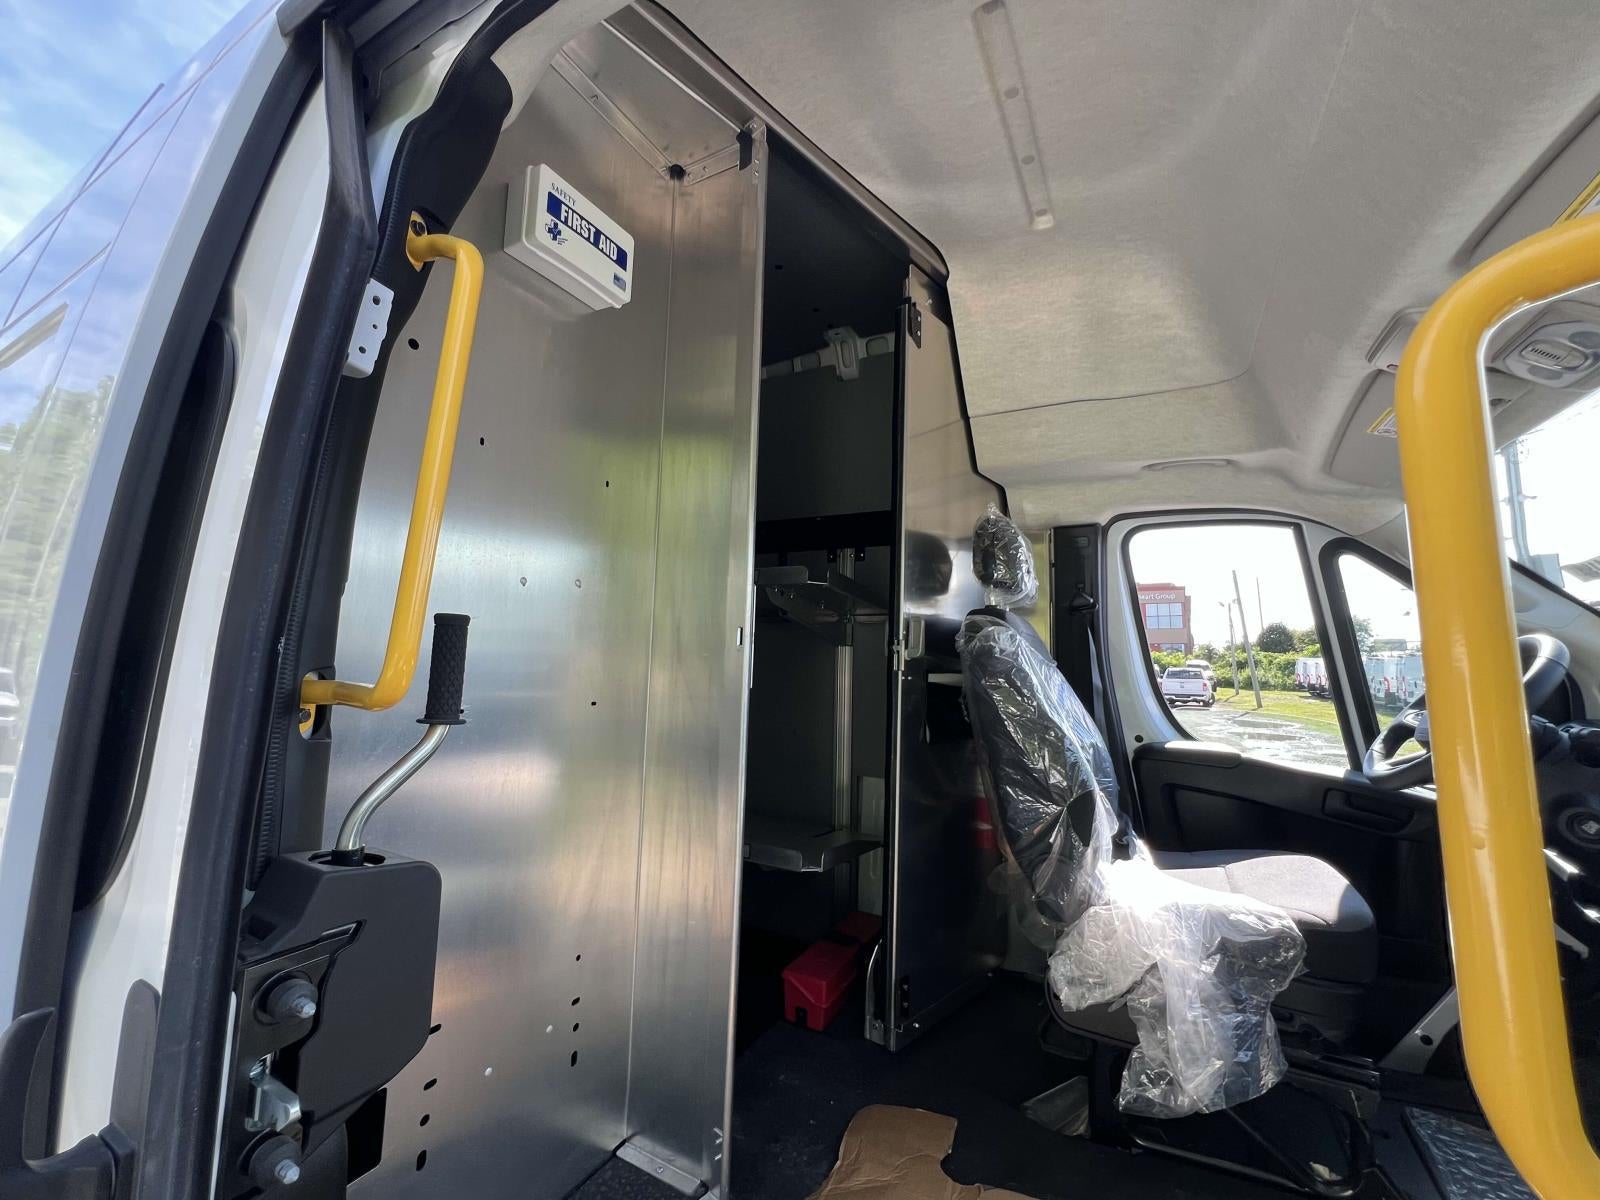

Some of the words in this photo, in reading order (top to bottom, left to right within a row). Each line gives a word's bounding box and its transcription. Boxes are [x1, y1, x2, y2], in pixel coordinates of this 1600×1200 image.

[551, 182, 576, 206] SAFETY
[561, 203, 596, 243] FIRST
[598, 234, 618, 261] AID
[1155, 593, 1176, 601] Group
